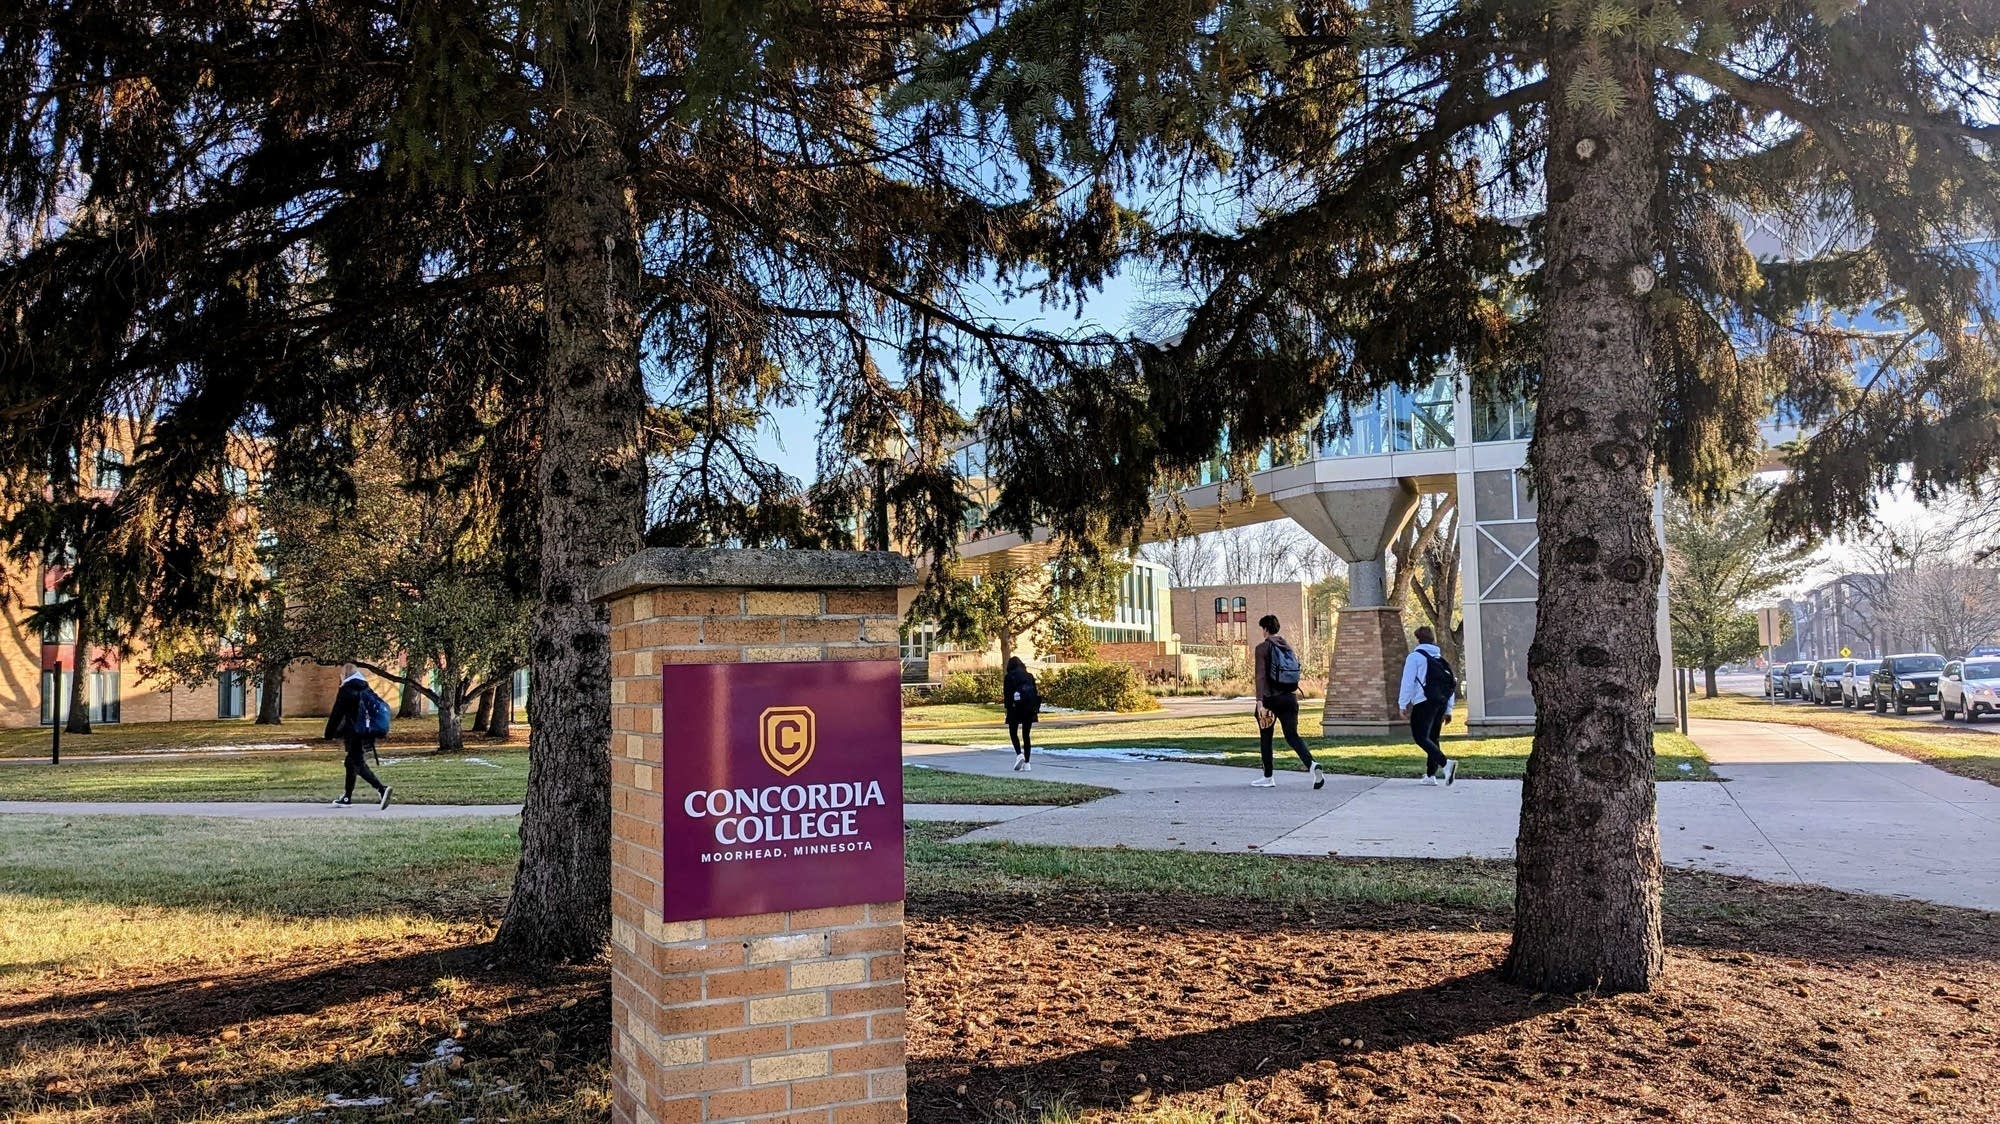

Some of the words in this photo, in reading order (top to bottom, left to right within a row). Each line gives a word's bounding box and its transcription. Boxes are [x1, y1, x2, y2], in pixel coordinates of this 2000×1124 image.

[775, 720, 800, 755] C
[684, 780, 885, 817] CONCORDIA
[715, 810, 858, 844] COLLEGE
[701, 849, 787, 863] MOORHEAD,
[794, 841, 872, 856] MINNESOTA
